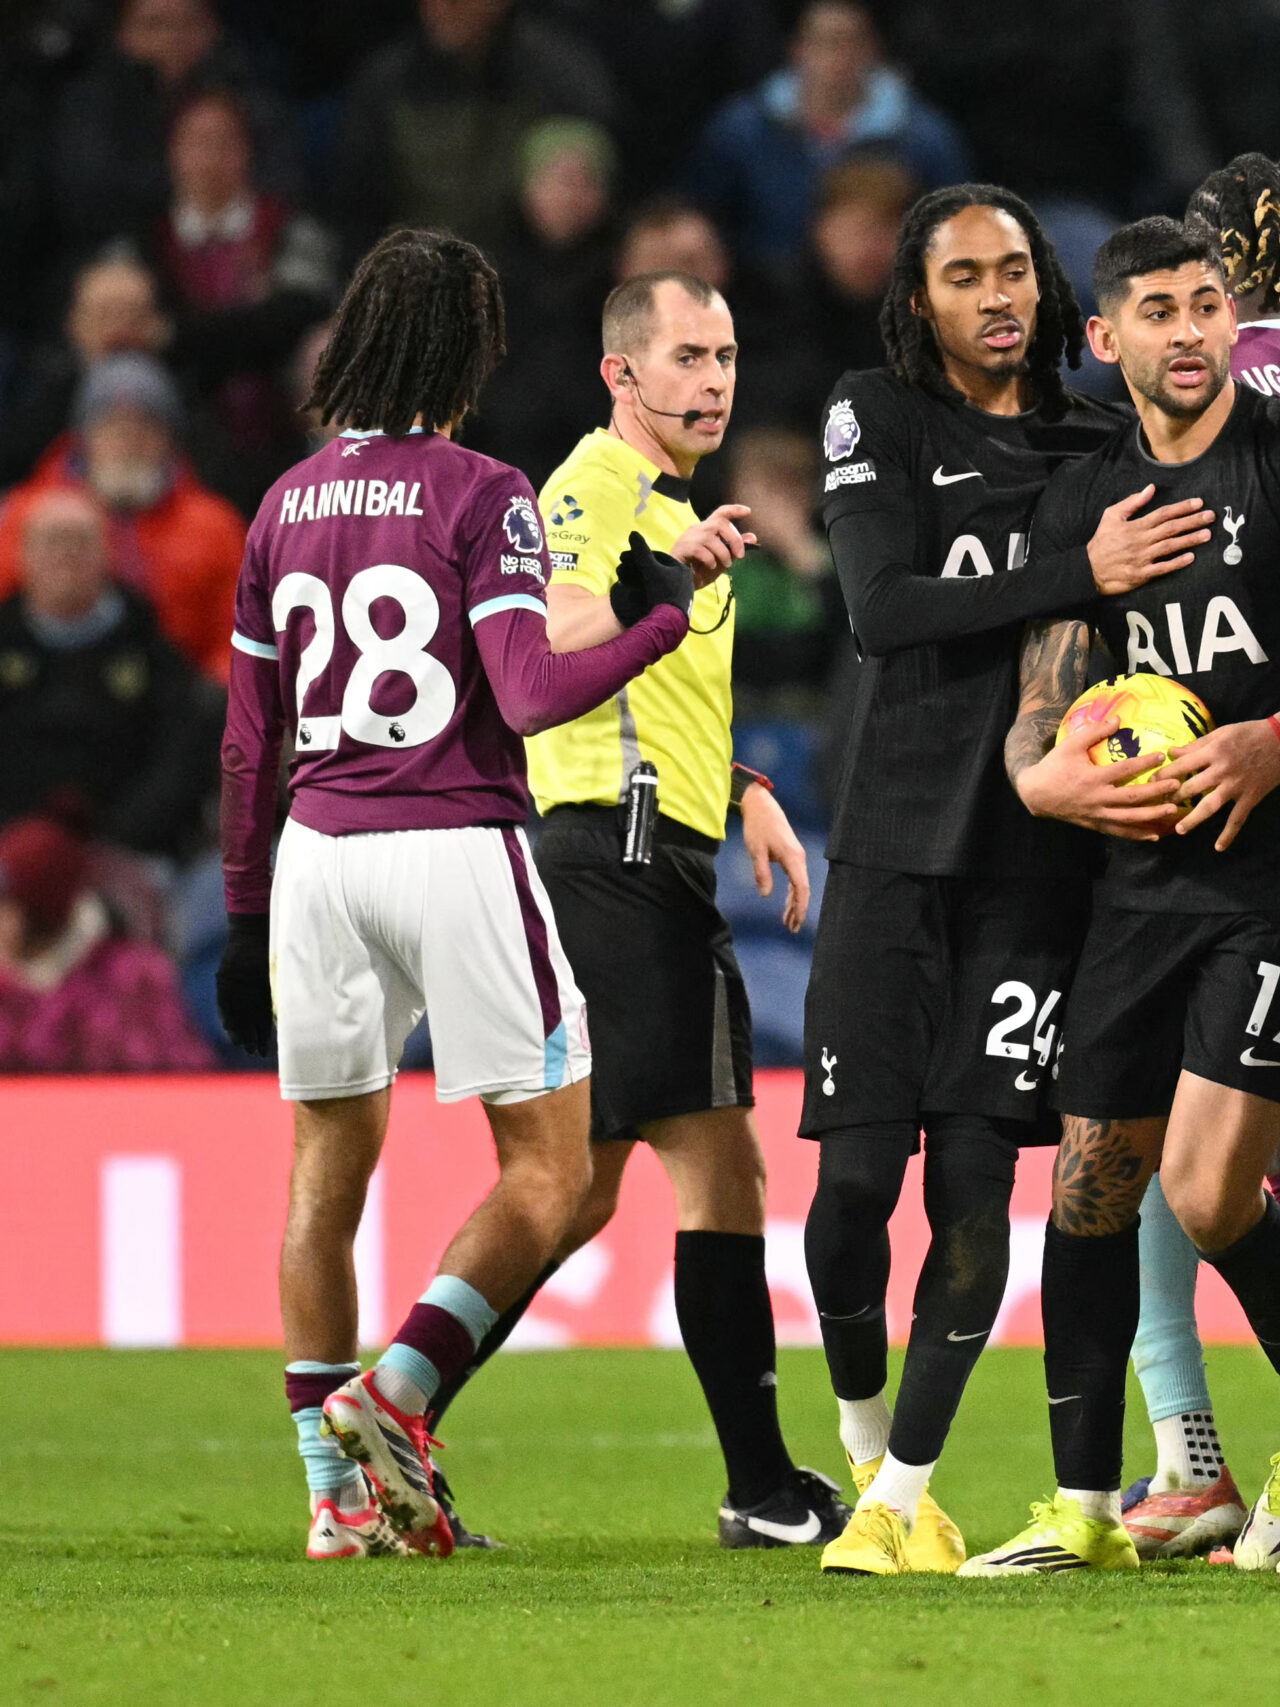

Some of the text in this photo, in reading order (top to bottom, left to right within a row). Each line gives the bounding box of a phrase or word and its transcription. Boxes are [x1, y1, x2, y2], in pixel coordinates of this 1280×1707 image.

[835, 462, 869, 476] room
[279, 479, 423, 525] HANNIBAL
[501, 554, 518, 566] No
[272, 564, 456, 751] 28
[1126, 595, 1269, 676] AIA
[986, 980, 1062, 1067] 24
